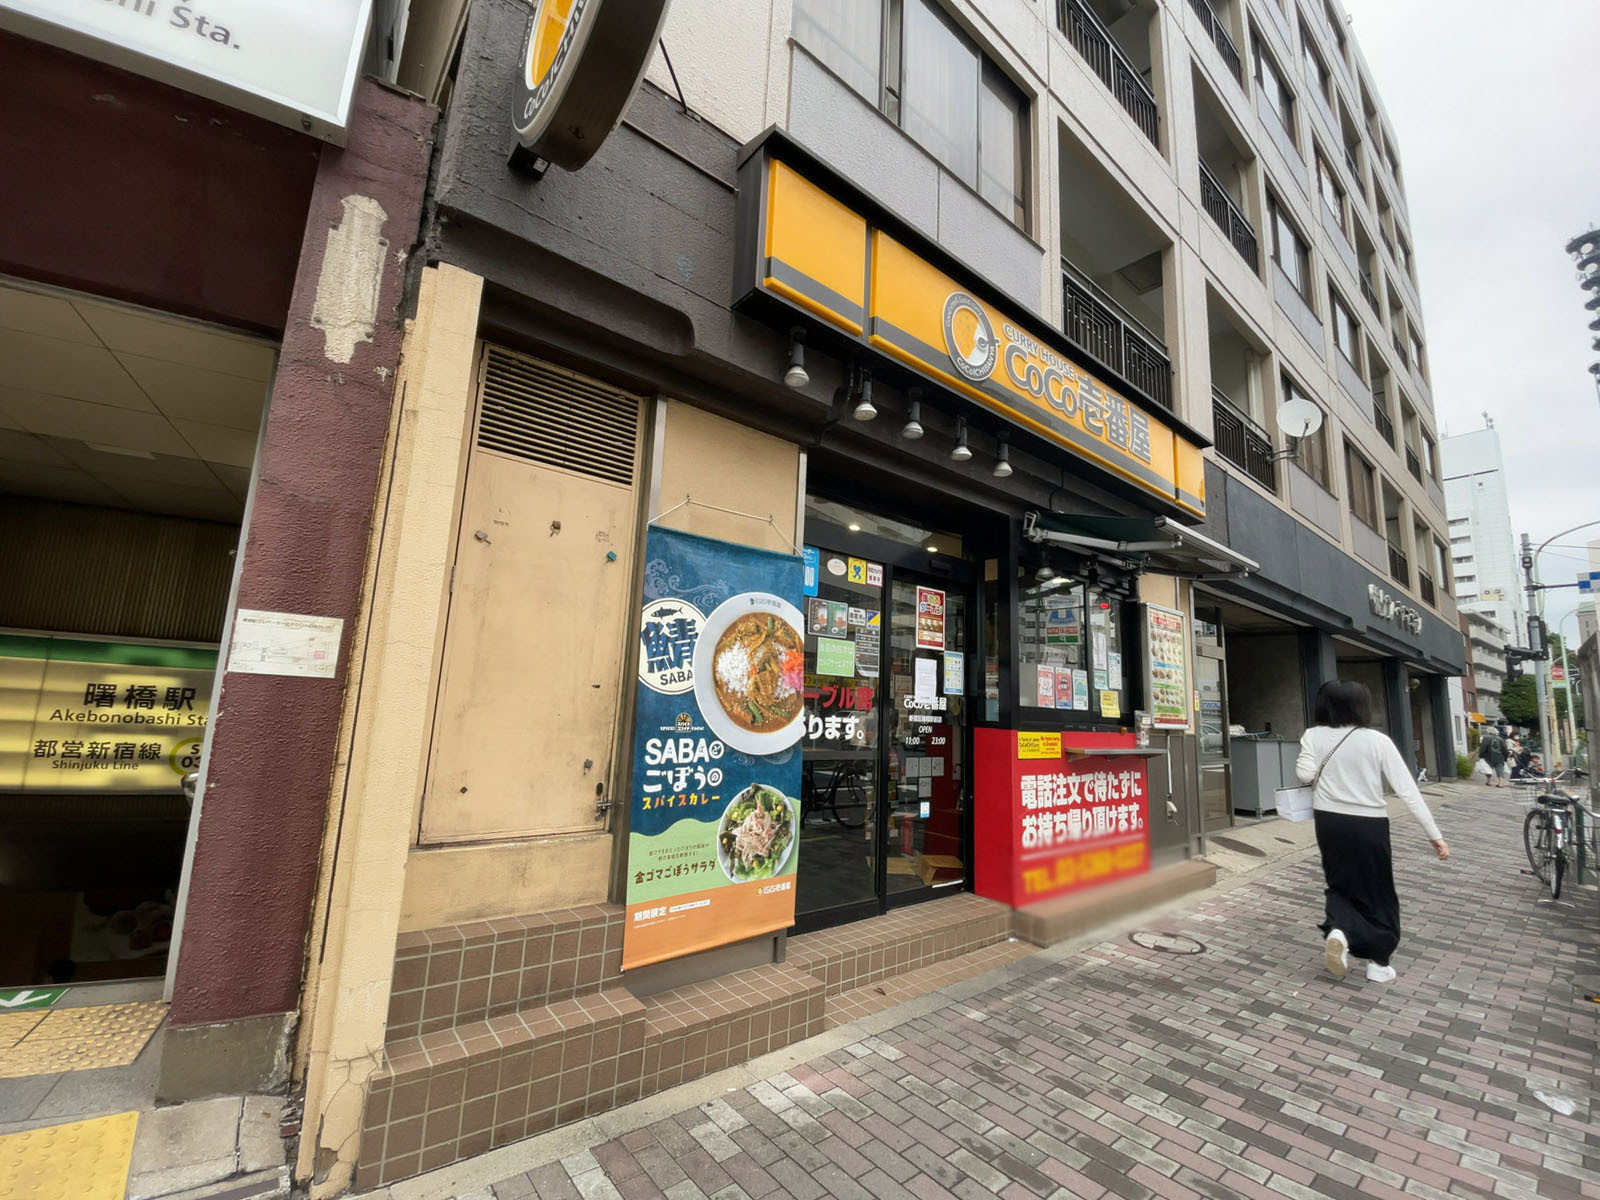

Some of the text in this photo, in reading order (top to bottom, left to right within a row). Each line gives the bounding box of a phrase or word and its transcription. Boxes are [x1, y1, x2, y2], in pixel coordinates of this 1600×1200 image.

[169, 5, 240, 50] Sta.
[1004, 324, 1076, 381] CURRY HOUSE
[1004, 342, 1152, 464] CoCo壱番屋
[641, 618, 700, 674] 鯖
[660, 669, 694, 686] SABA
[84, 683, 197, 712] 曙橋駅
[50, 709, 181, 726] Akebonobashi
[919, 725, 933, 734] OPEN
[33, 740, 162, 761] 都営新宿線
[52, 760, 139, 771] Shinjuku Line
[643, 765, 723, 793] ごぼうの
[642, 793, 720, 810] スパイスカレー
[1021, 771, 1142, 809] 電話注文で待たずに
[1022, 802, 1143, 848] お持ち帰り頂けます。
[634, 859, 716, 885] 金ゴマごぼうサラダ
